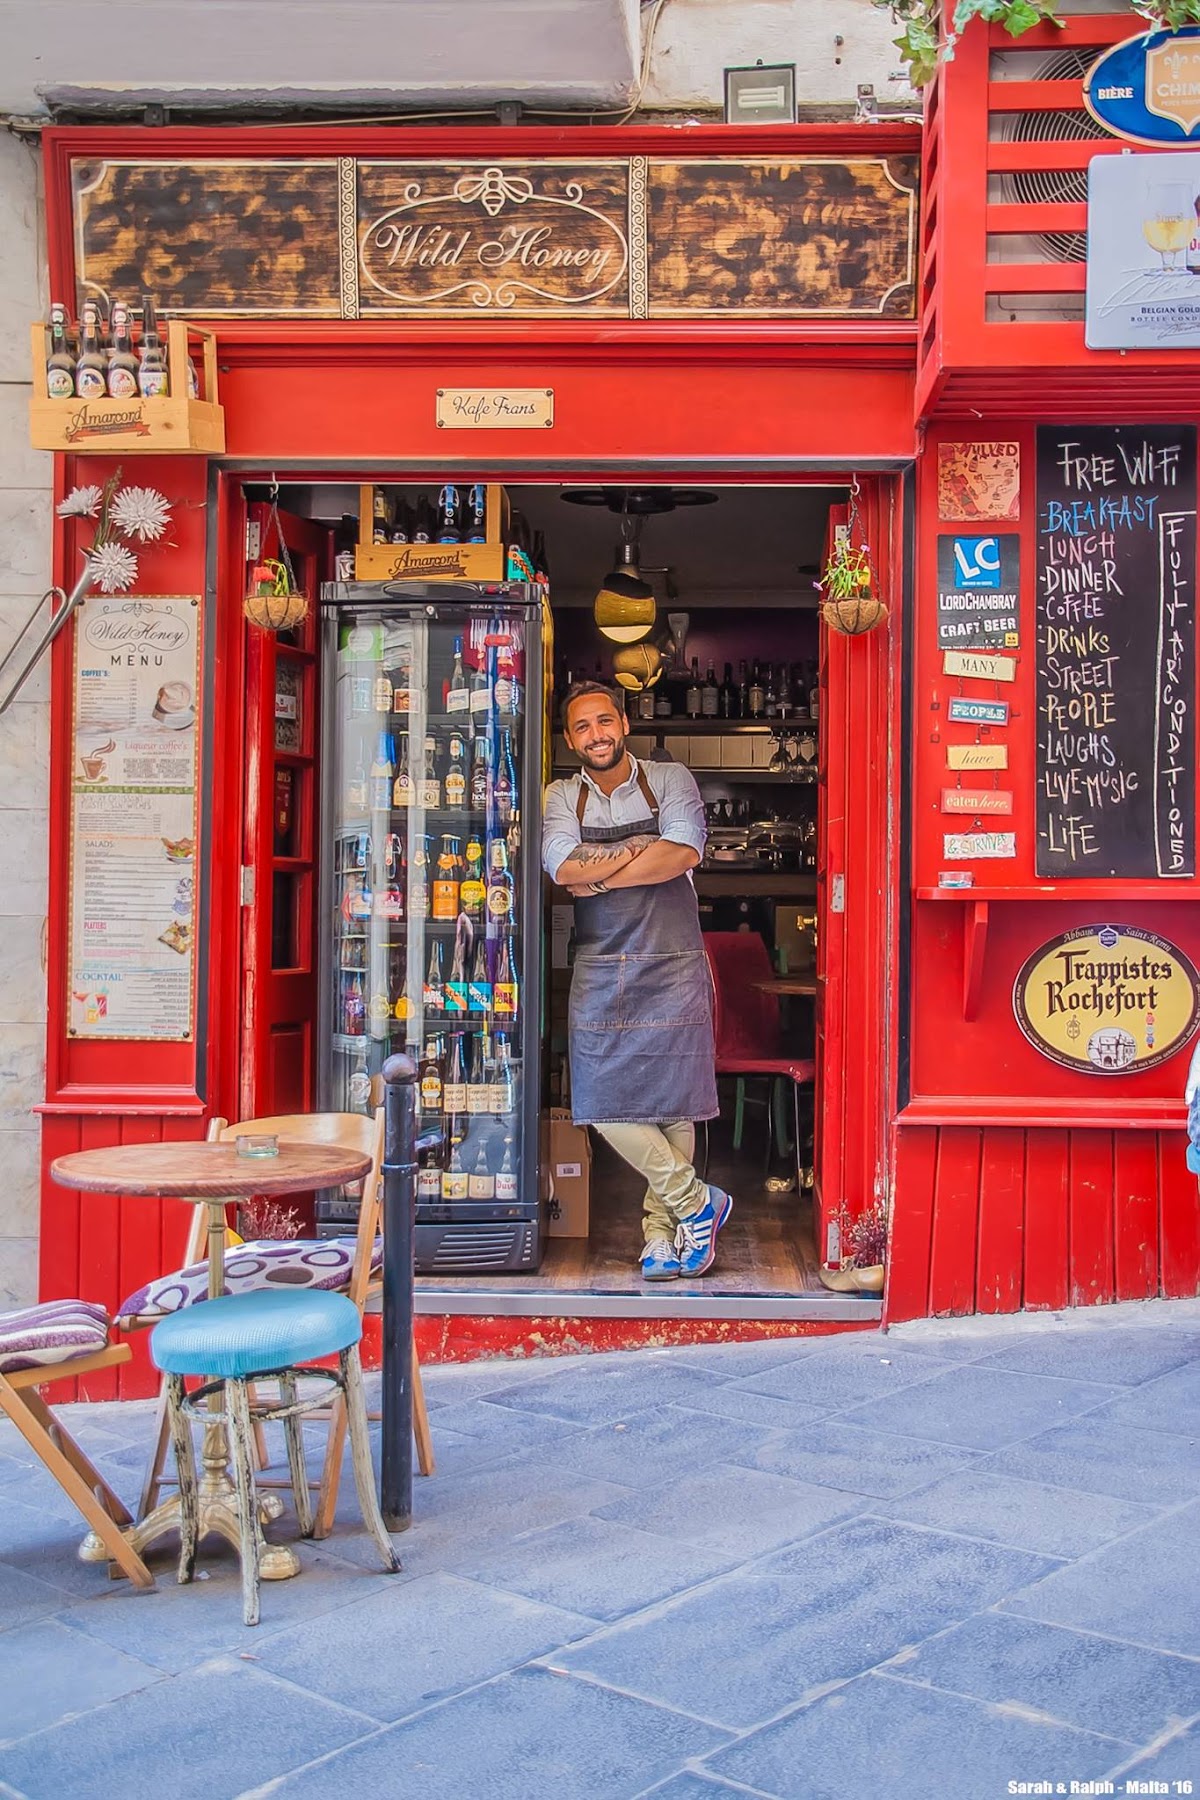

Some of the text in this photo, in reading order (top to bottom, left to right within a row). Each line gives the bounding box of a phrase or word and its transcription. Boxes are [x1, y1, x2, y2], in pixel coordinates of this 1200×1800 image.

[1098, 86, 1134, 100] BIÈRE
[375, 224, 612, 284] Wild Honey
[1141, 306, 1176, 315] BELGIAN
[65, 404, 143, 435] Amarcord
[452, 395, 536, 423] Kafe Frans
[1056, 443, 1117, 492] FREE
[1042, 494, 1159, 537] BREAKFAST
[388, 549, 460, 575] Amarcord
[954, 538, 1000, 579] LC
[1049, 531, 1115, 565] LUNCH
[1044, 560, 1124, 596] DINNER
[1165, 517, 1188, 627] FULLY
[91, 620, 184, 646] Wild Honey
[940, 617, 1016, 638] CRAFT BEER
[111, 655, 163, 666] MENU
[960, 658, 998, 673] MANY
[1047, 656, 1120, 695] STREET
[952, 704, 1005, 719] PEOPLE
[1045, 692, 1117, 731] PEOPLE
[961, 750, 994, 765] have
[1045, 731, 1116, 767] LAUGHS
[947, 794, 978, 807] eaten
[76, 972, 123, 981] COCKTAIL
[1055, 950, 1172, 988] Trappistes
[1044, 981, 1159, 1018] Rochefort
